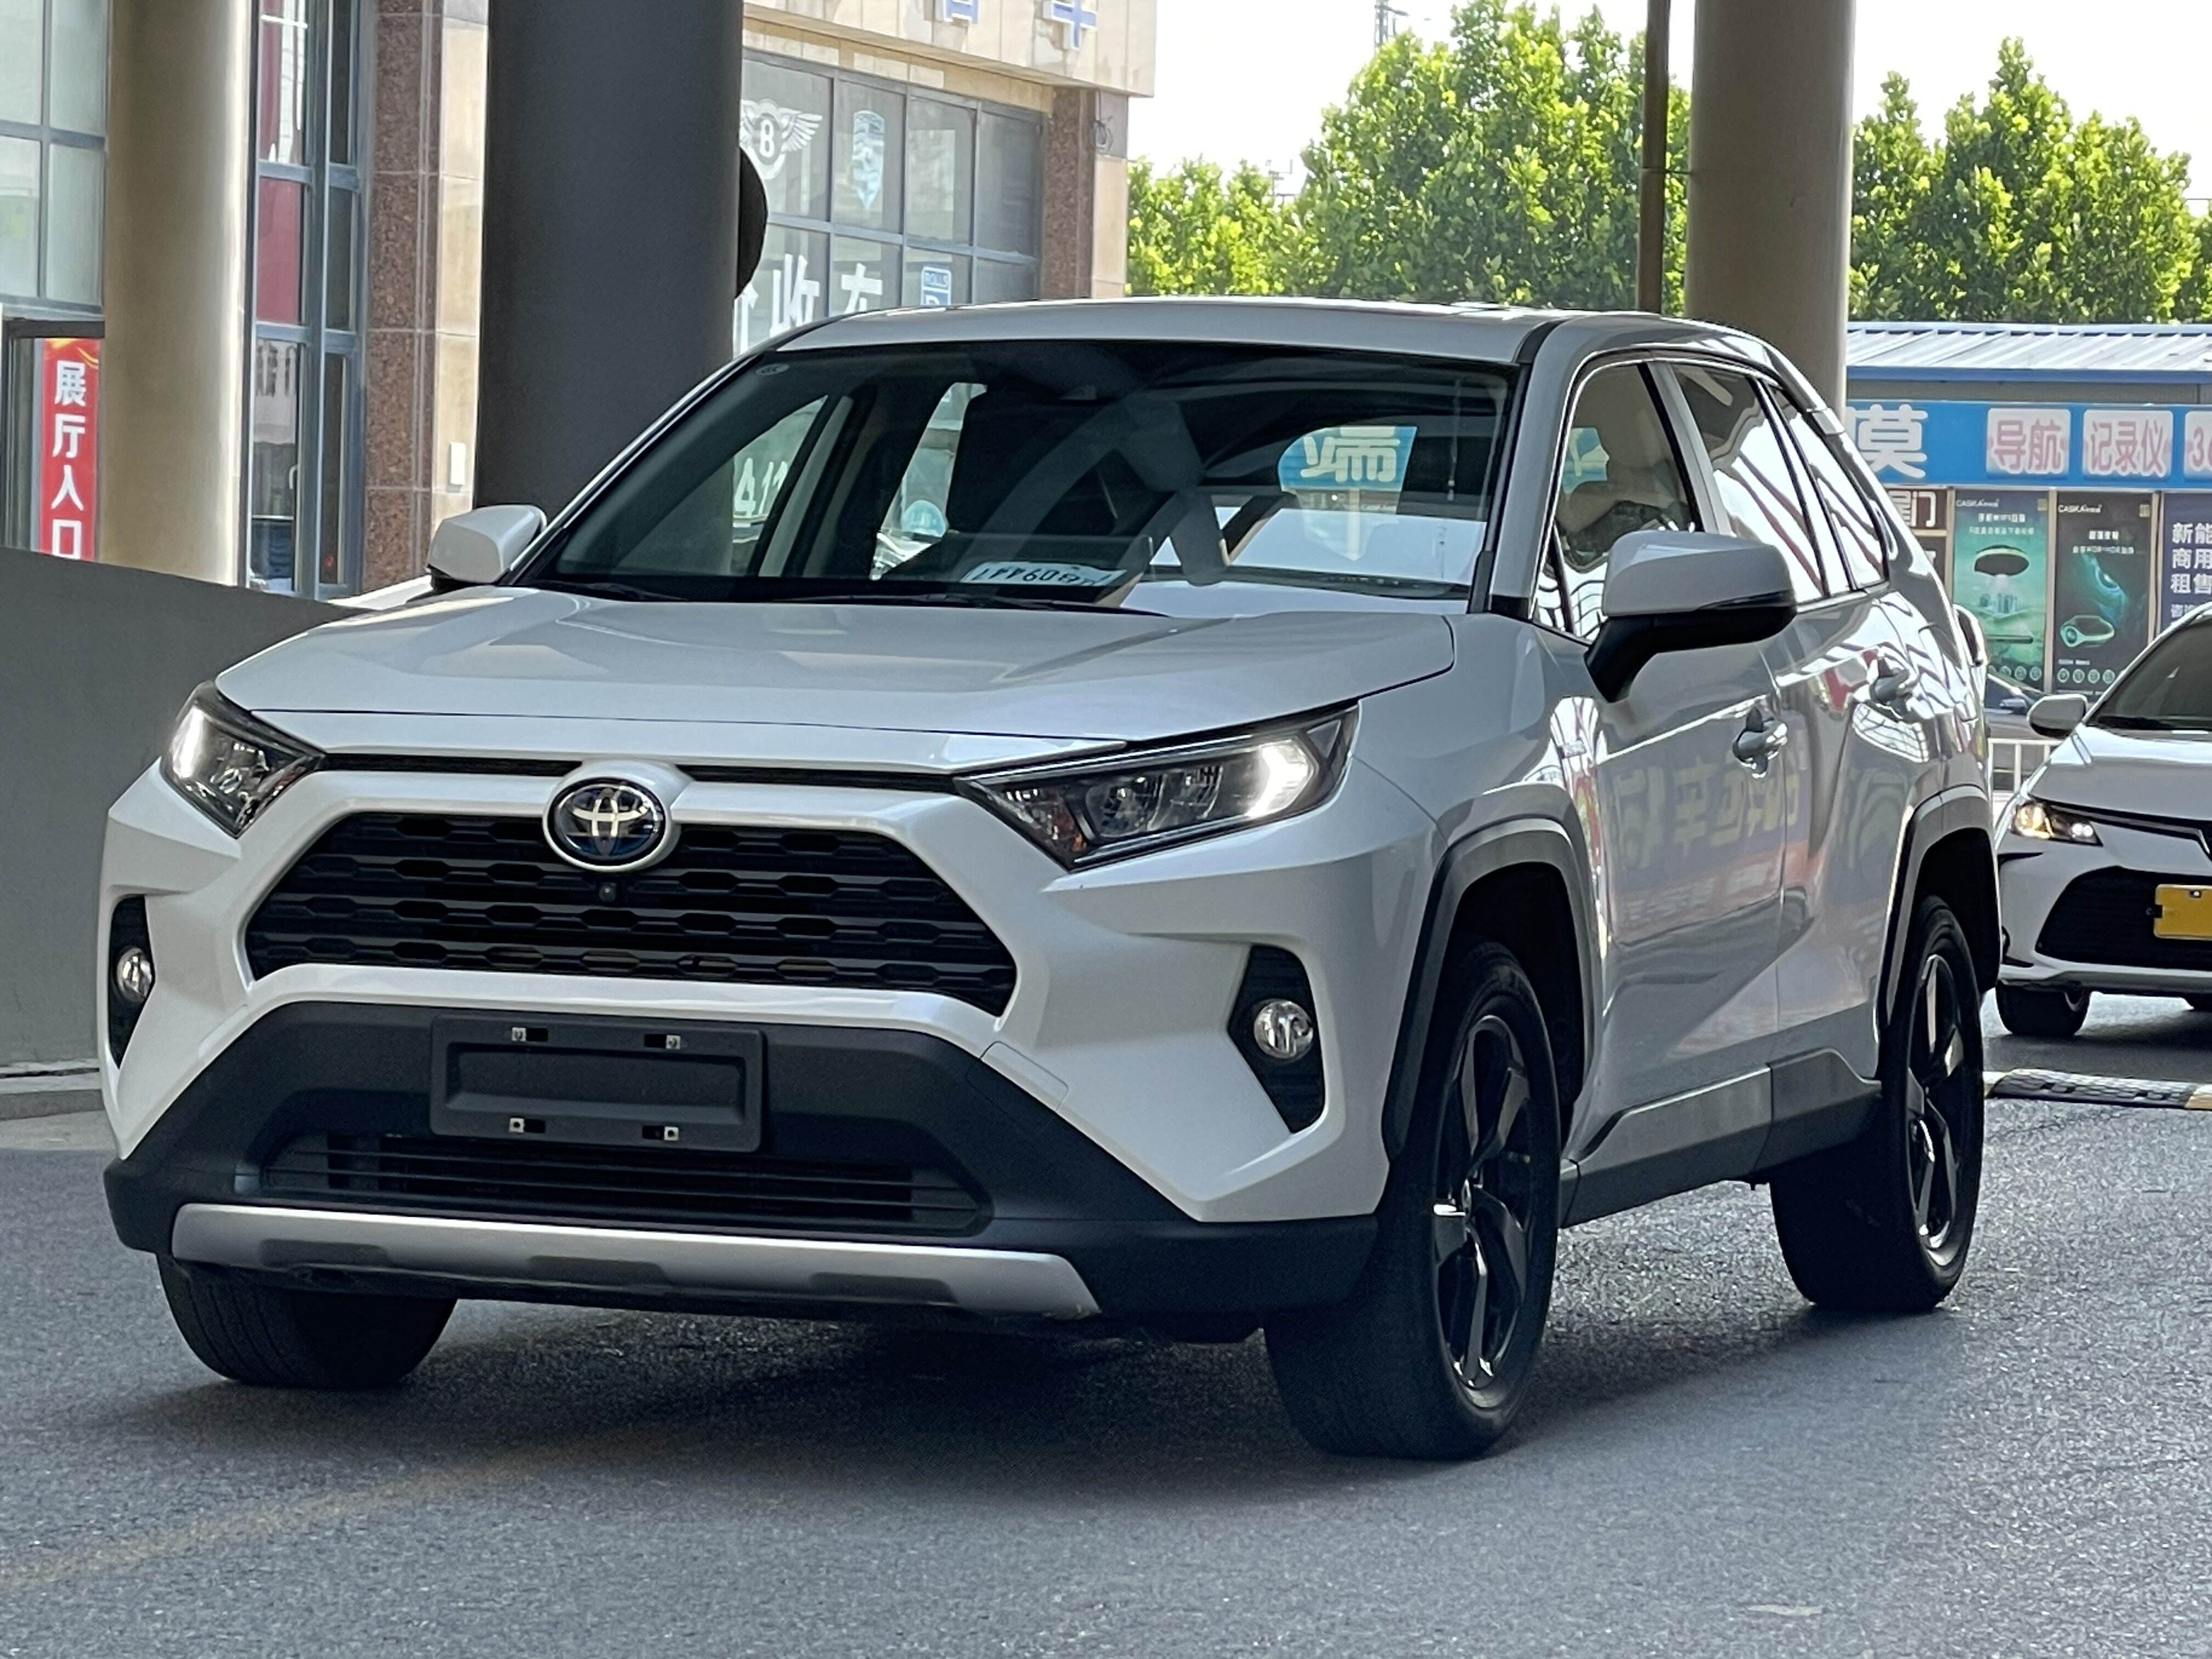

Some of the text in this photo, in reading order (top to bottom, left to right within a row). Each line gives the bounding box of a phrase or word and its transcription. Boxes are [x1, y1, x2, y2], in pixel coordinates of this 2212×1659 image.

[1993, 419, 2062, 470] 导航
[2090, 419, 2163, 473] 记录仪
